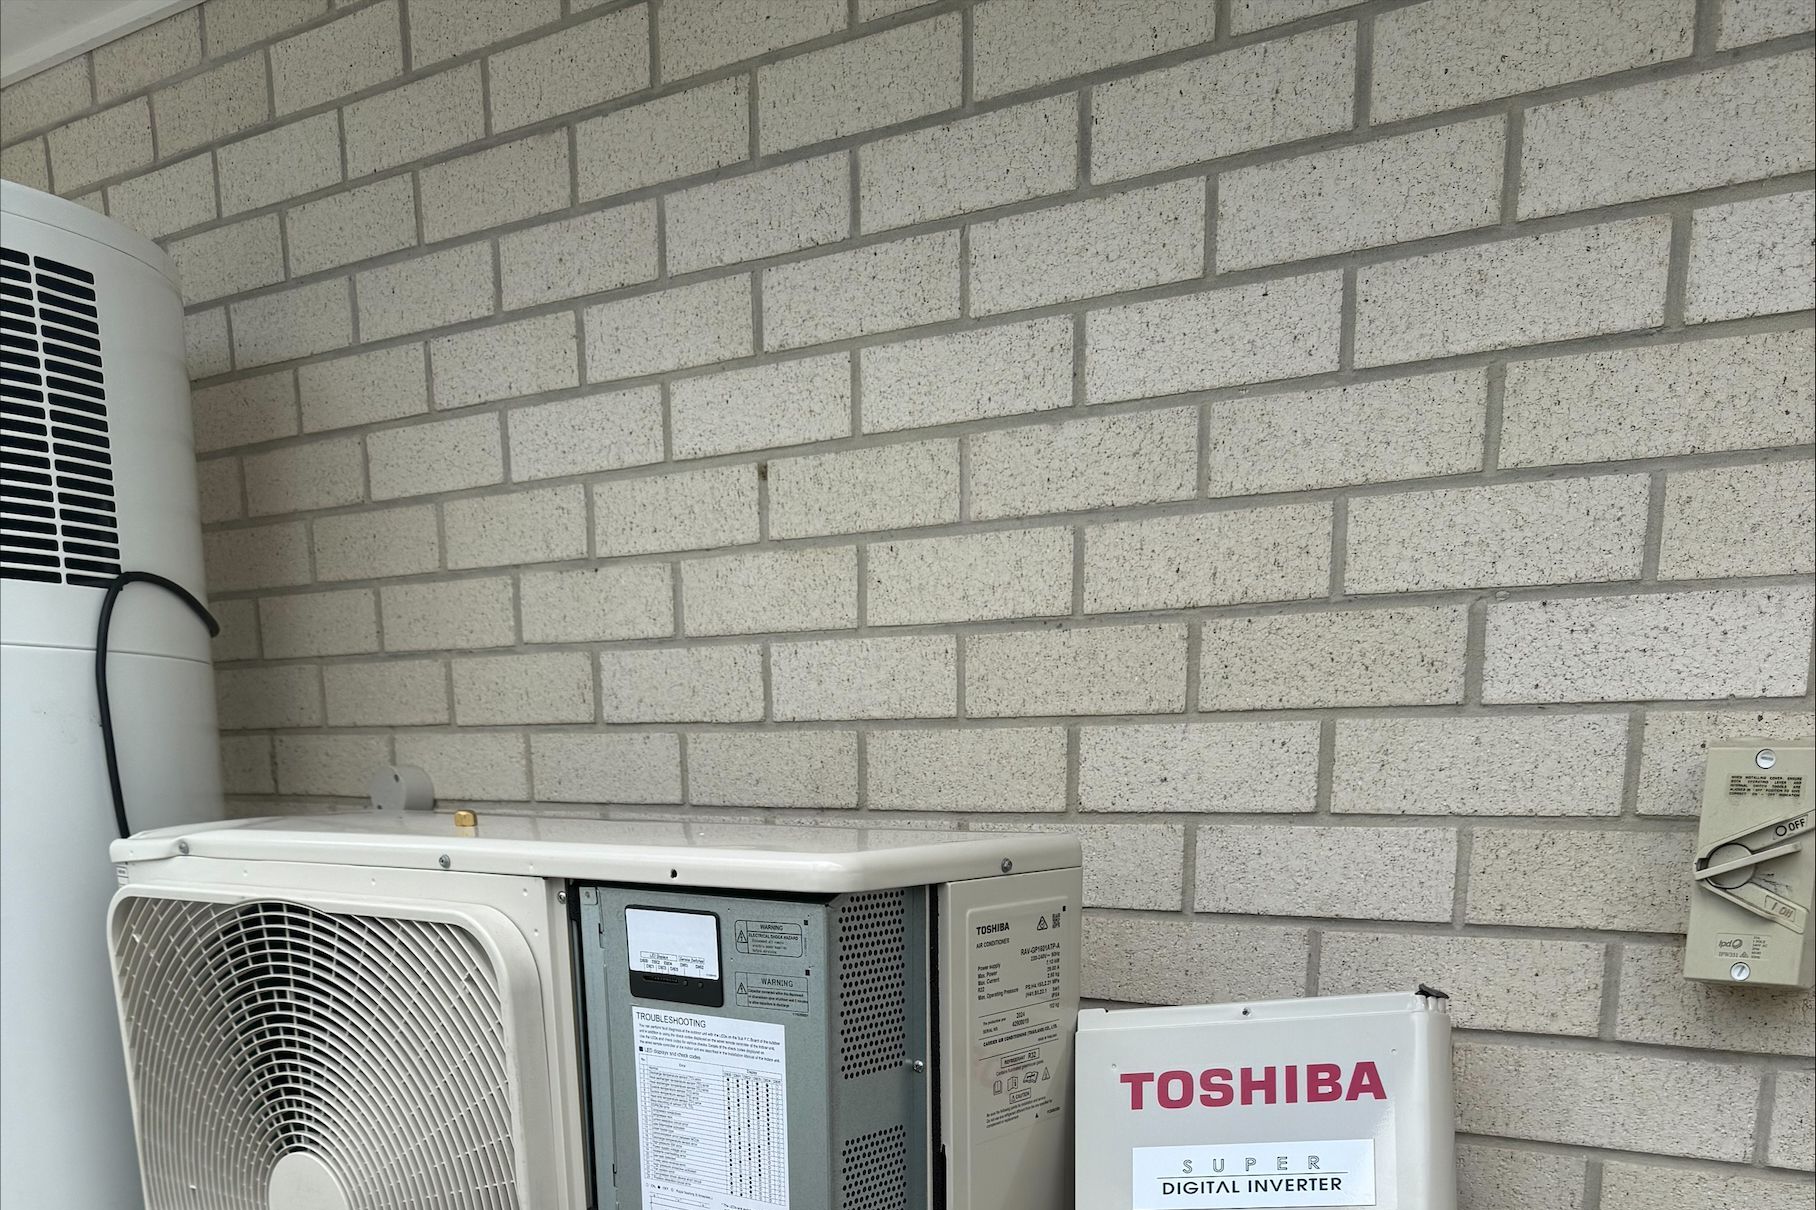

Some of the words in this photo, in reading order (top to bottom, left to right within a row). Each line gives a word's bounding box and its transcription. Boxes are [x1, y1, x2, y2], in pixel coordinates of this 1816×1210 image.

[1788, 818, 1806, 831] OFF
[976, 922, 1010, 935] TOSHIBA
[761, 978, 794, 987] WARNING
[636, 1011, 706, 1028] TROUBLESHOOTING
[1028, 1052, 1037, 1060] R32
[1120, 1061, 1387, 1110] TOSHIBA
[1182, 1156, 1320, 1174] SUPER
[1162, 1178, 1240, 1195] DIGITAL
[1248, 1176, 1342, 1193] INVERTER
